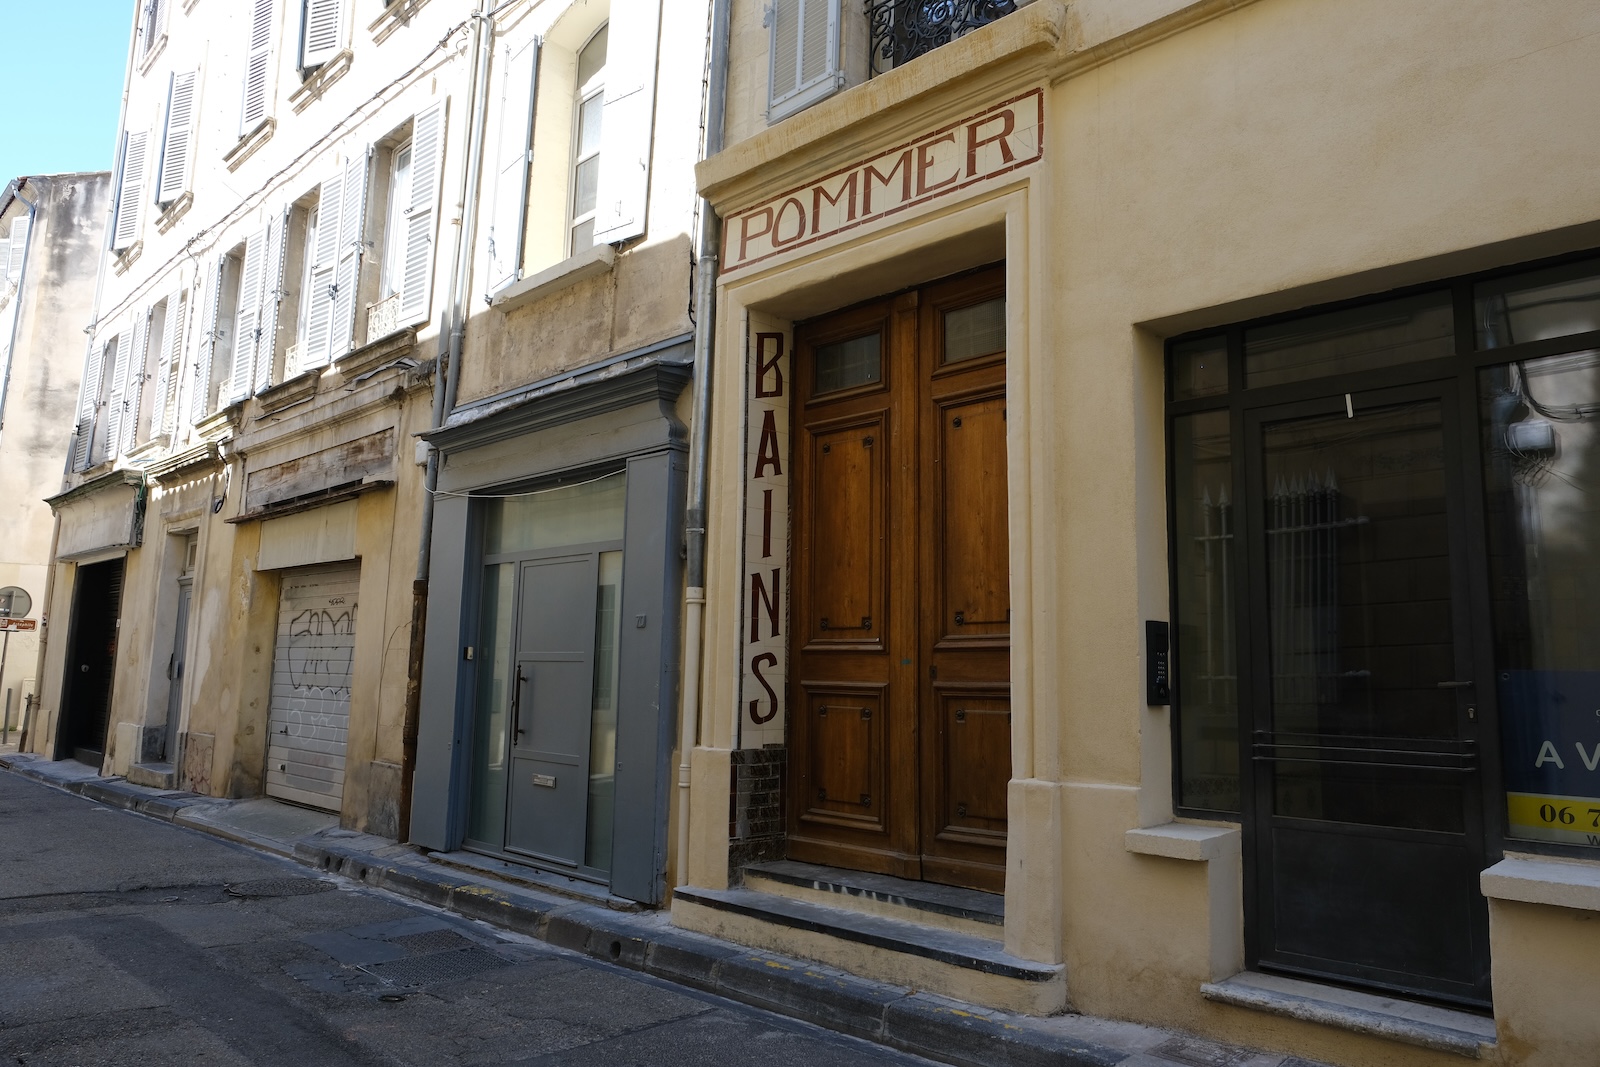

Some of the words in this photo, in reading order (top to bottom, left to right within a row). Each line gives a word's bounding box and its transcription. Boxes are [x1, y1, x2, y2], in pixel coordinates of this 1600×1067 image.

[737, 108, 1016, 262] POMMER
[749, 332, 784, 725] BAINS
[1539, 803, 1575, 825] 06
